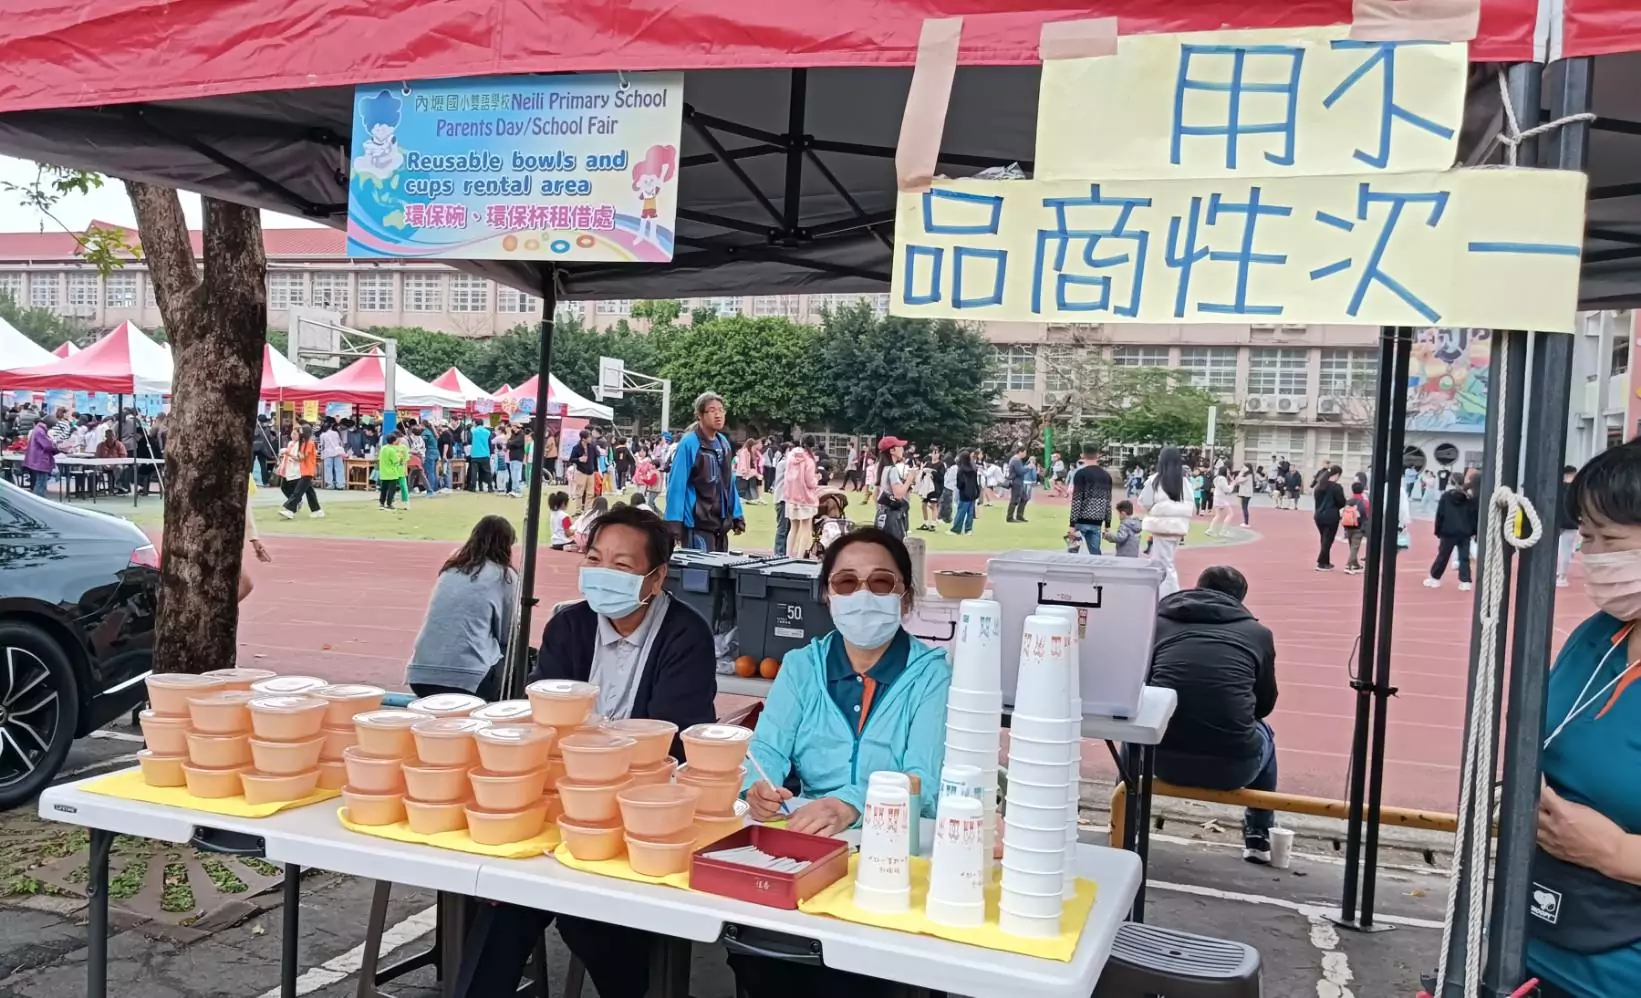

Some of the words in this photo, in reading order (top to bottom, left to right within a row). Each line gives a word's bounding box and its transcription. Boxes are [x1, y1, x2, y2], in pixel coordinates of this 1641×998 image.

[511, 92, 544, 111] Neili
[549, 91, 610, 110] Primary
[614, 89, 667, 108] School
[436, 119, 493, 137] Parents
[496, 116, 583, 136] Day/School
[588, 115, 619, 135] Fair
[407, 151, 502, 171] Reusable
[512, 150, 577, 170] bowls
[586, 150, 628, 170] and
[405, 177, 453, 198] cups
[463, 175, 532, 196] rental
[541, 178, 592, 195] area
[404, 204, 616, 230] 環保碗、環保杯租借處
